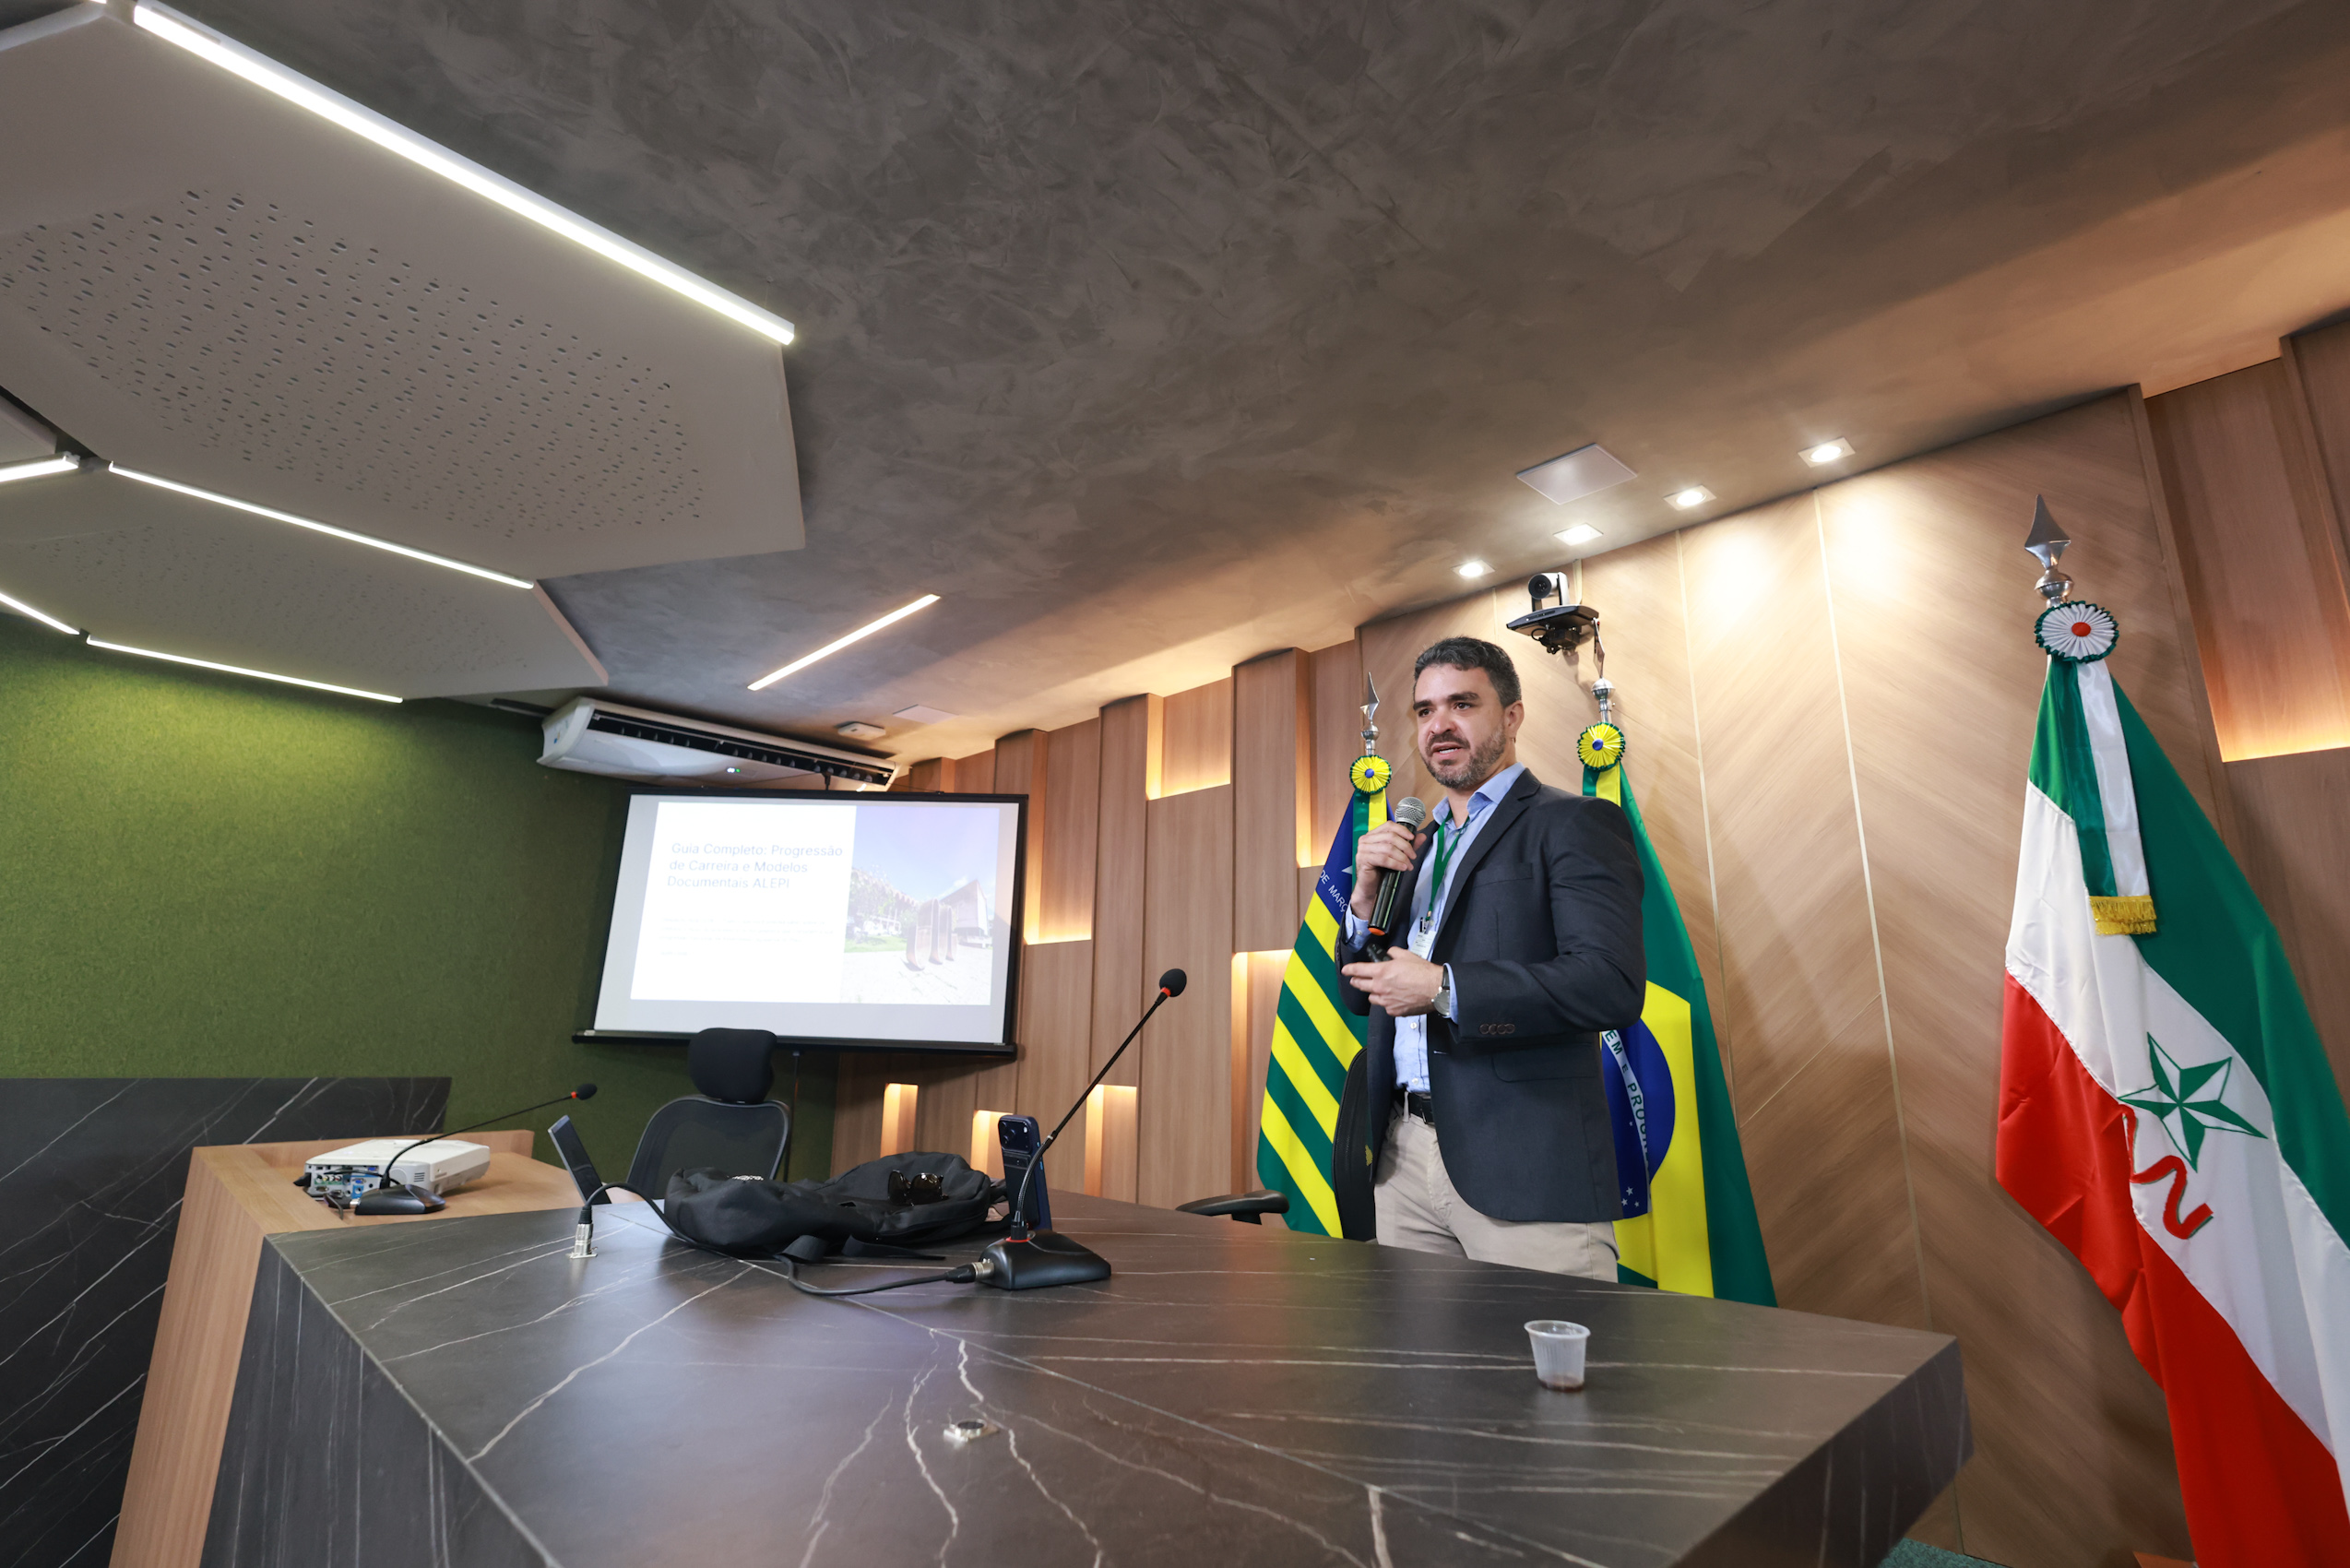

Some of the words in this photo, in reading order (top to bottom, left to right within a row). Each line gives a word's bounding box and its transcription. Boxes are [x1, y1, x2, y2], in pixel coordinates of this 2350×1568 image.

[671, 842, 699, 854] Guia
[703, 843, 767, 857] Completo:
[771, 845, 843, 859] Progressão
[669, 860, 685, 871] de
[688, 860, 739, 872] Carreira
[742, 862, 750, 872] e
[754, 861, 808, 873] Modelos
[667, 875, 749, 888] Documentais
[752, 877, 790, 889] ALEPI
[1328, 885, 1348, 912] MARÇ
[1621, 1063, 1629, 1074] E
